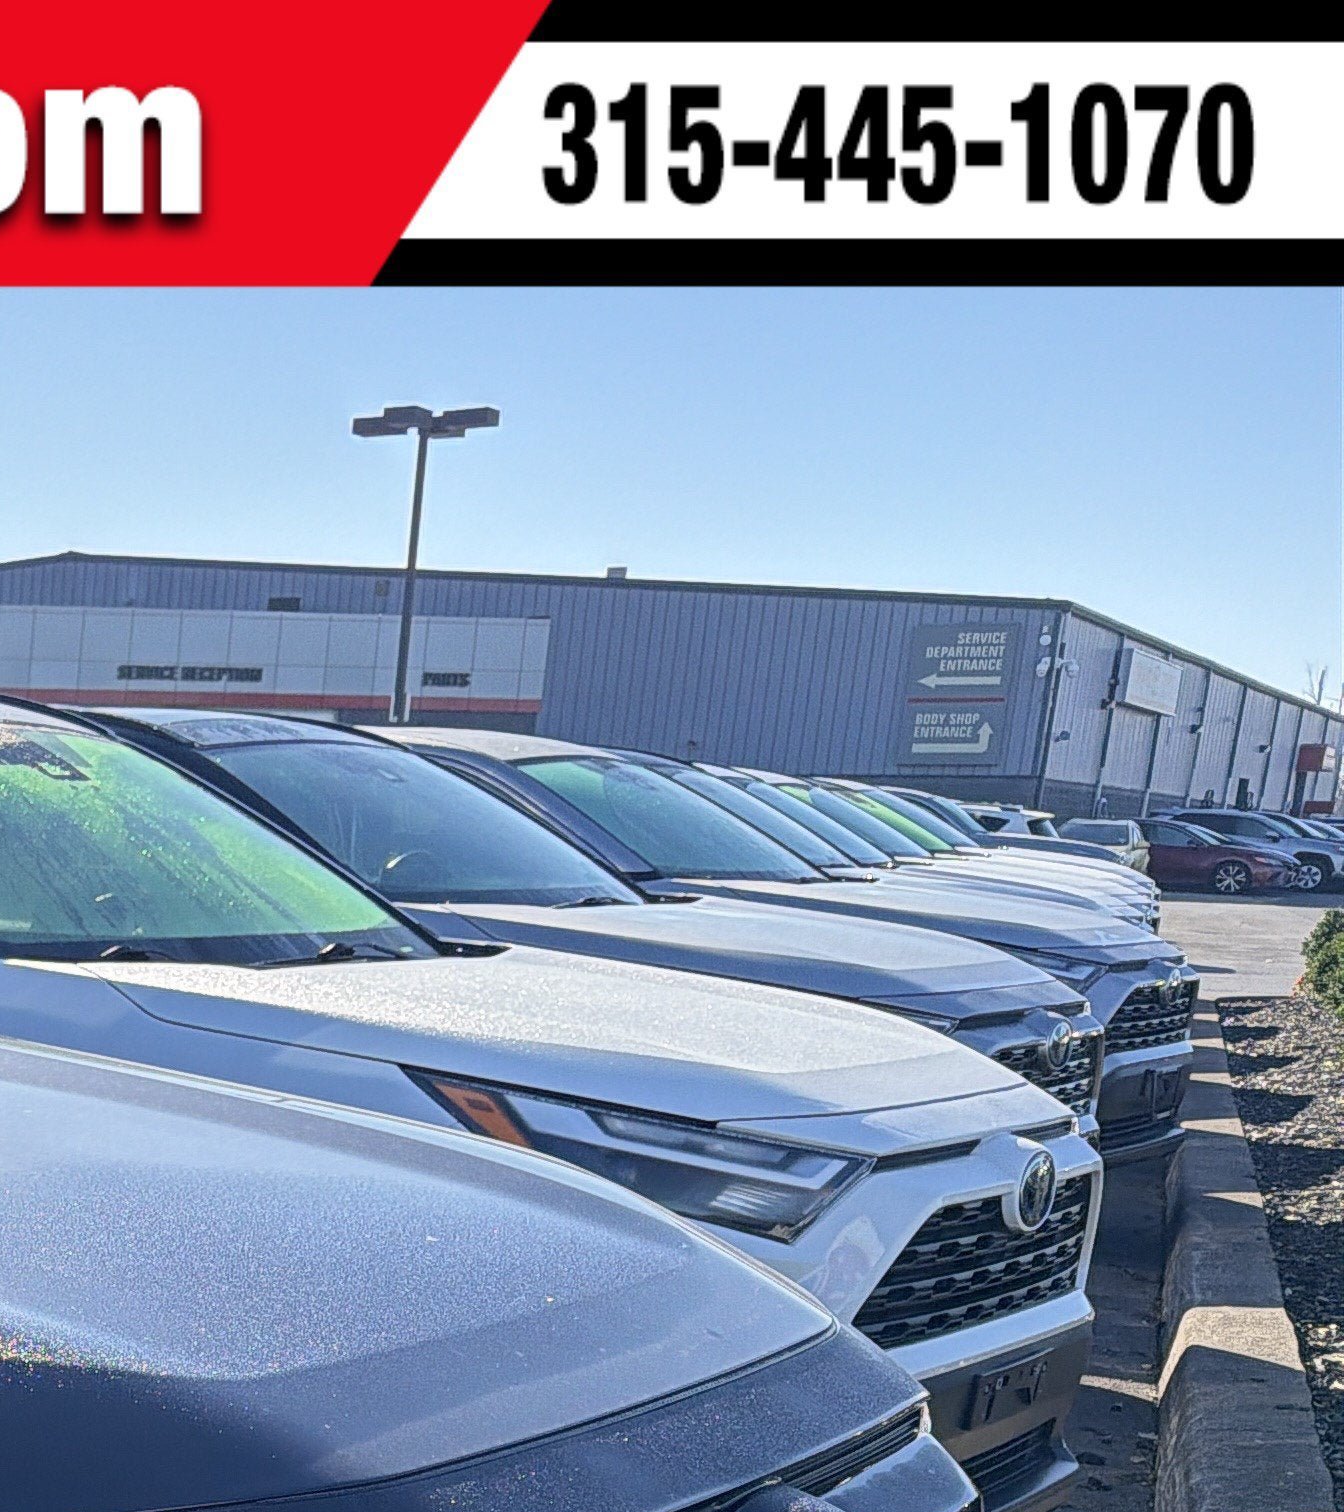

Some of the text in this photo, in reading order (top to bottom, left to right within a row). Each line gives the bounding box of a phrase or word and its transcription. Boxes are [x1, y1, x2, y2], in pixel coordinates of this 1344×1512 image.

[958, 632, 1007, 644] SERVICE
[926, 646, 1006, 658] DEPARTMENT
[940, 659, 1002, 671] ENTRANCE
[916, 713, 980, 725] BODY SHOP
[914, 726, 973, 738] ENTRANCE
